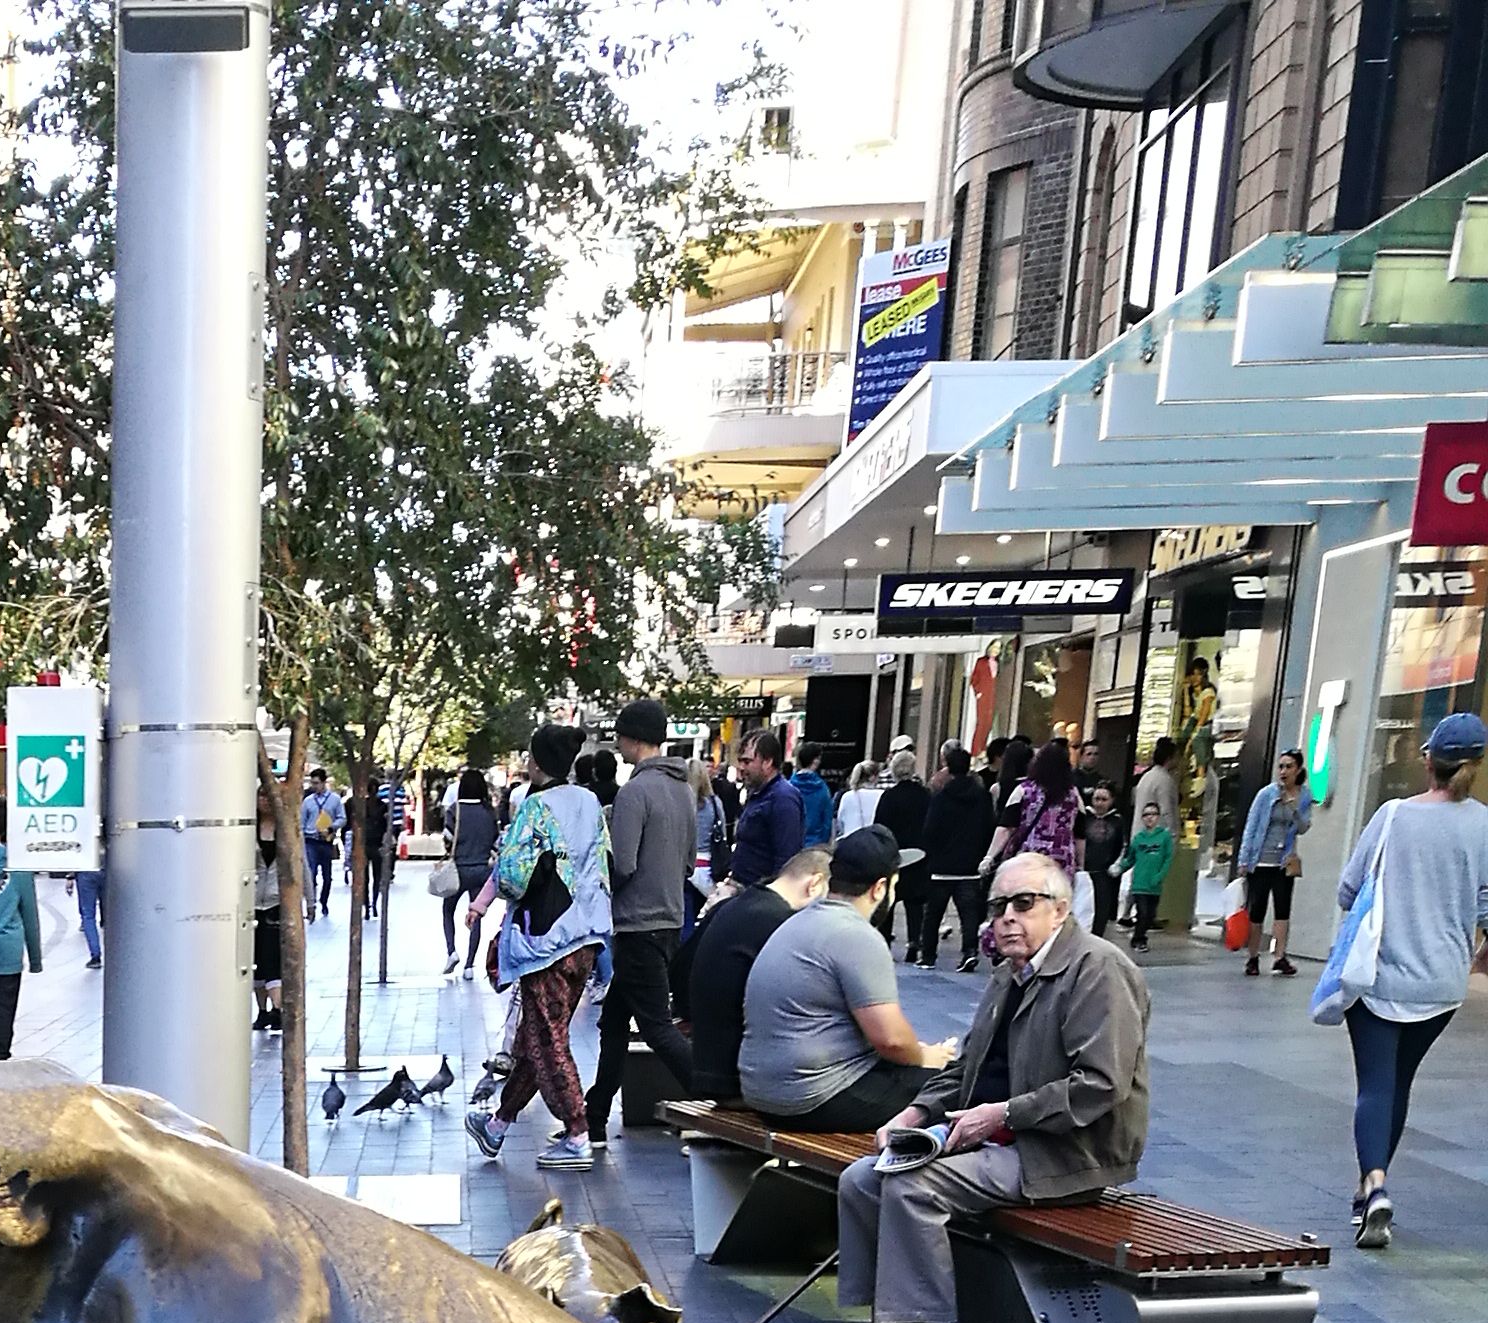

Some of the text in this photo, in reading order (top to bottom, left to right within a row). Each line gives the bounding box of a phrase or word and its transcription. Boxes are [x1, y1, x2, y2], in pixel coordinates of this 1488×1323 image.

[865, 284, 903, 304] lease
[865, 300, 911, 341] LEASED
[1443, 462, 1488, 504] C
[889, 578, 1124, 608] SKECHERS
[24, 813, 78, 834] AED
